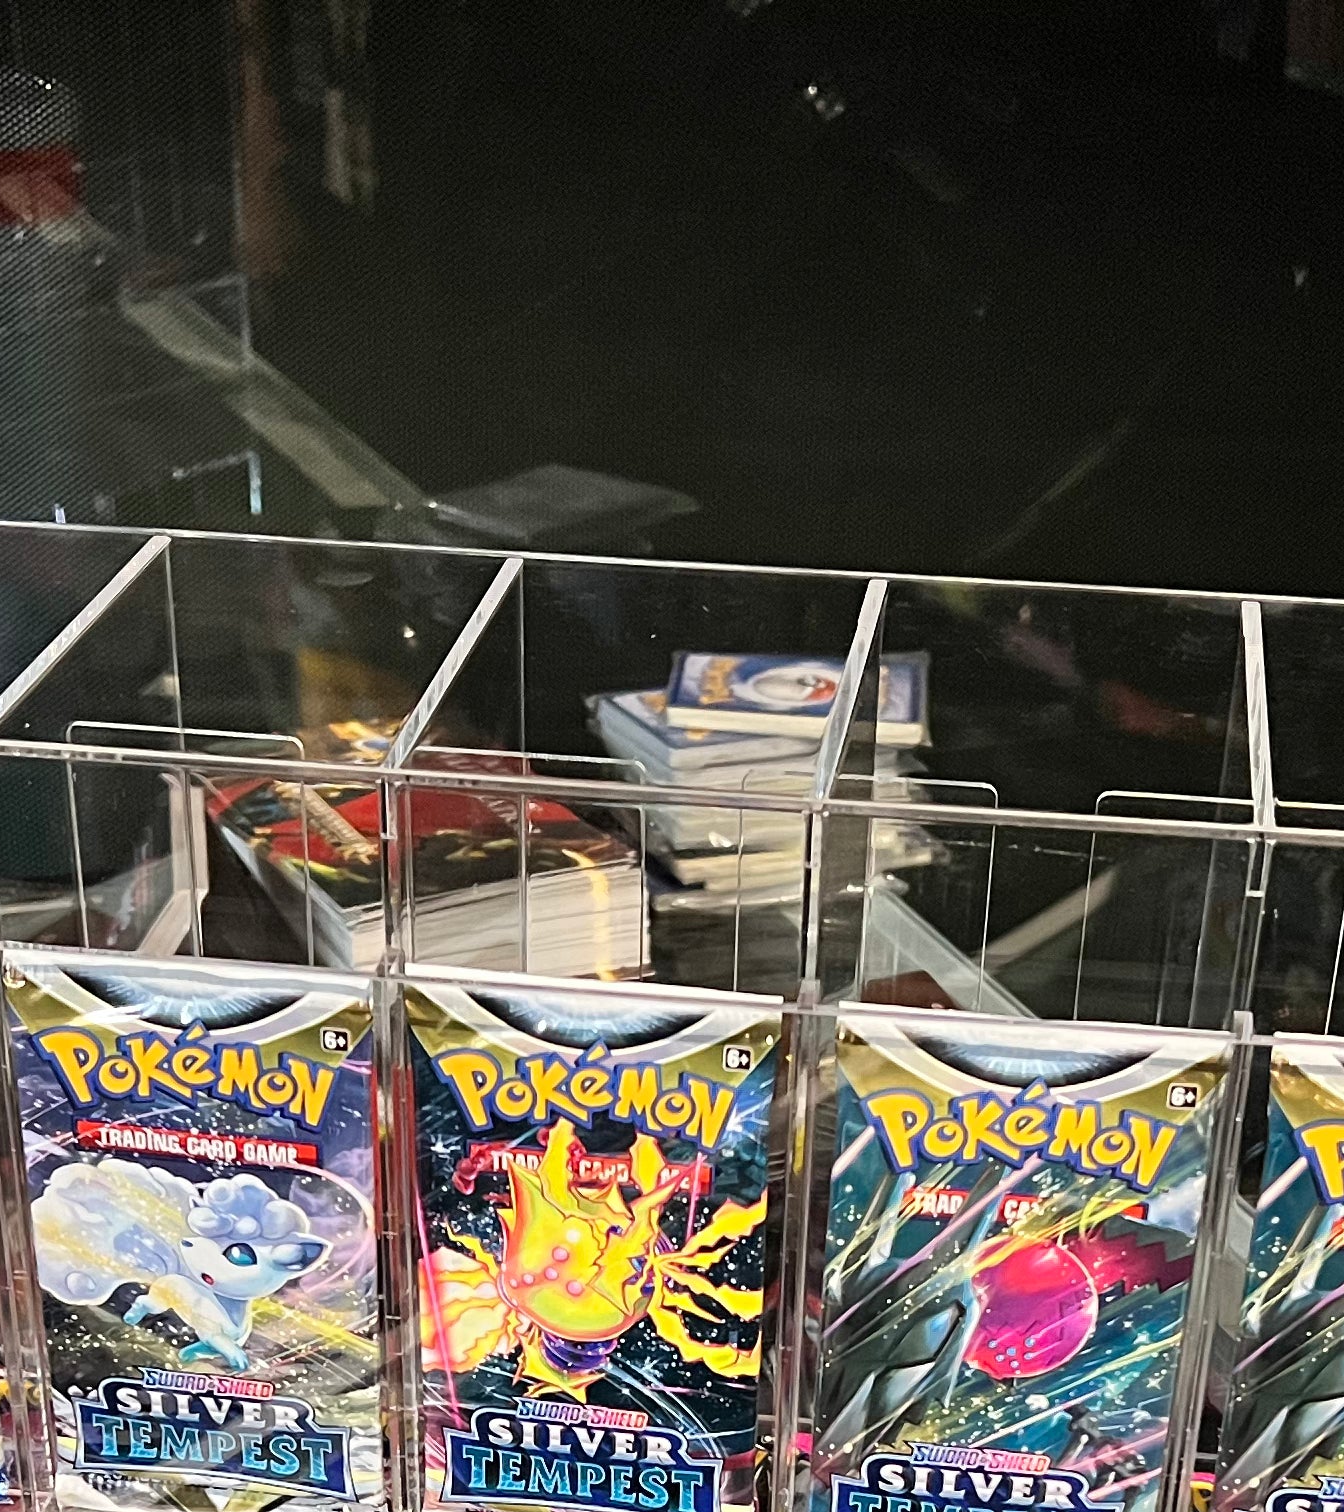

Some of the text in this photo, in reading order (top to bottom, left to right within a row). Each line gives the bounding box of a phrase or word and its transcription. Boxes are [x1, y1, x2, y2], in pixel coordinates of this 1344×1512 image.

[323, 1031, 350, 1051] 6+
[726, 1049, 751, 1068] 6+
[1169, 1087, 1196, 1106] 6+
[99, 1125, 298, 1166] TRADING CARD GAME
[114, 1385, 306, 1434] SILVER
[89, 1412, 333, 1481] TEMPEST
[486, 1416, 678, 1466] SILVER
[877, 1459, 1078, 1511] SILVER
